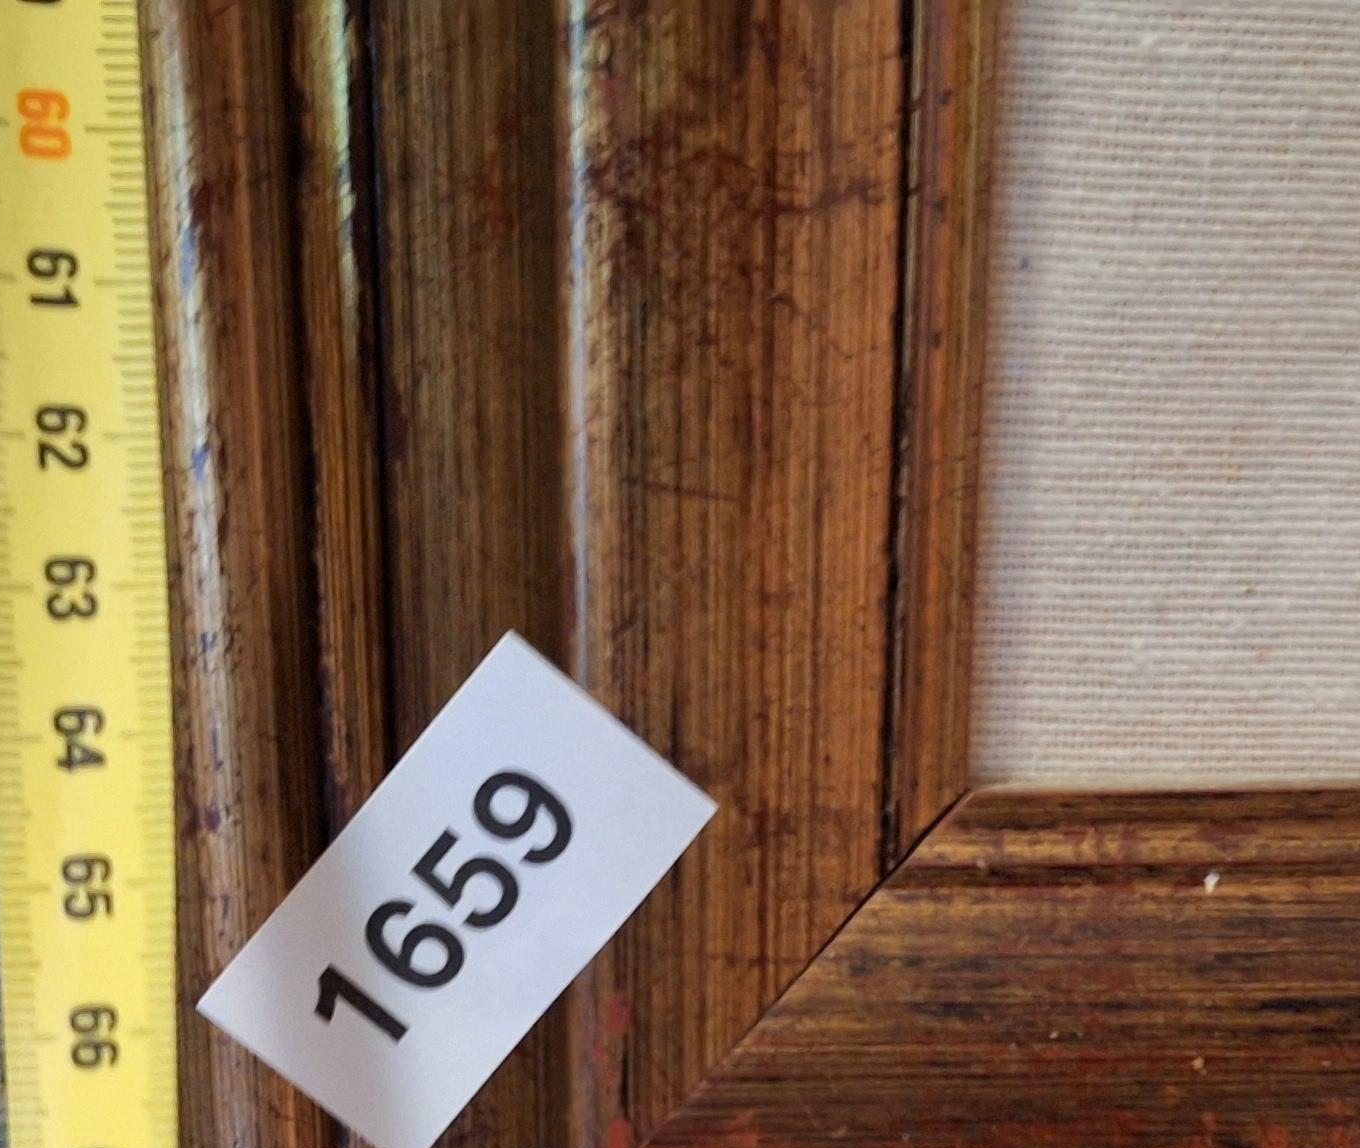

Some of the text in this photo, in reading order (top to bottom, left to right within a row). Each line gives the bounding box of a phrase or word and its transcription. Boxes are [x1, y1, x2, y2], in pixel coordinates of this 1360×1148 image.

[15, 88, 70, 160] 60
[25, 247, 80, 308] 61
[33, 404, 90, 471] 62
[42, 556, 99, 623] 63
[51, 706, 106, 774] 64
[60, 854, 114, 922] 65
[314, 769, 573, 1043] 1659
[68, 1004, 120, 1070] 66
